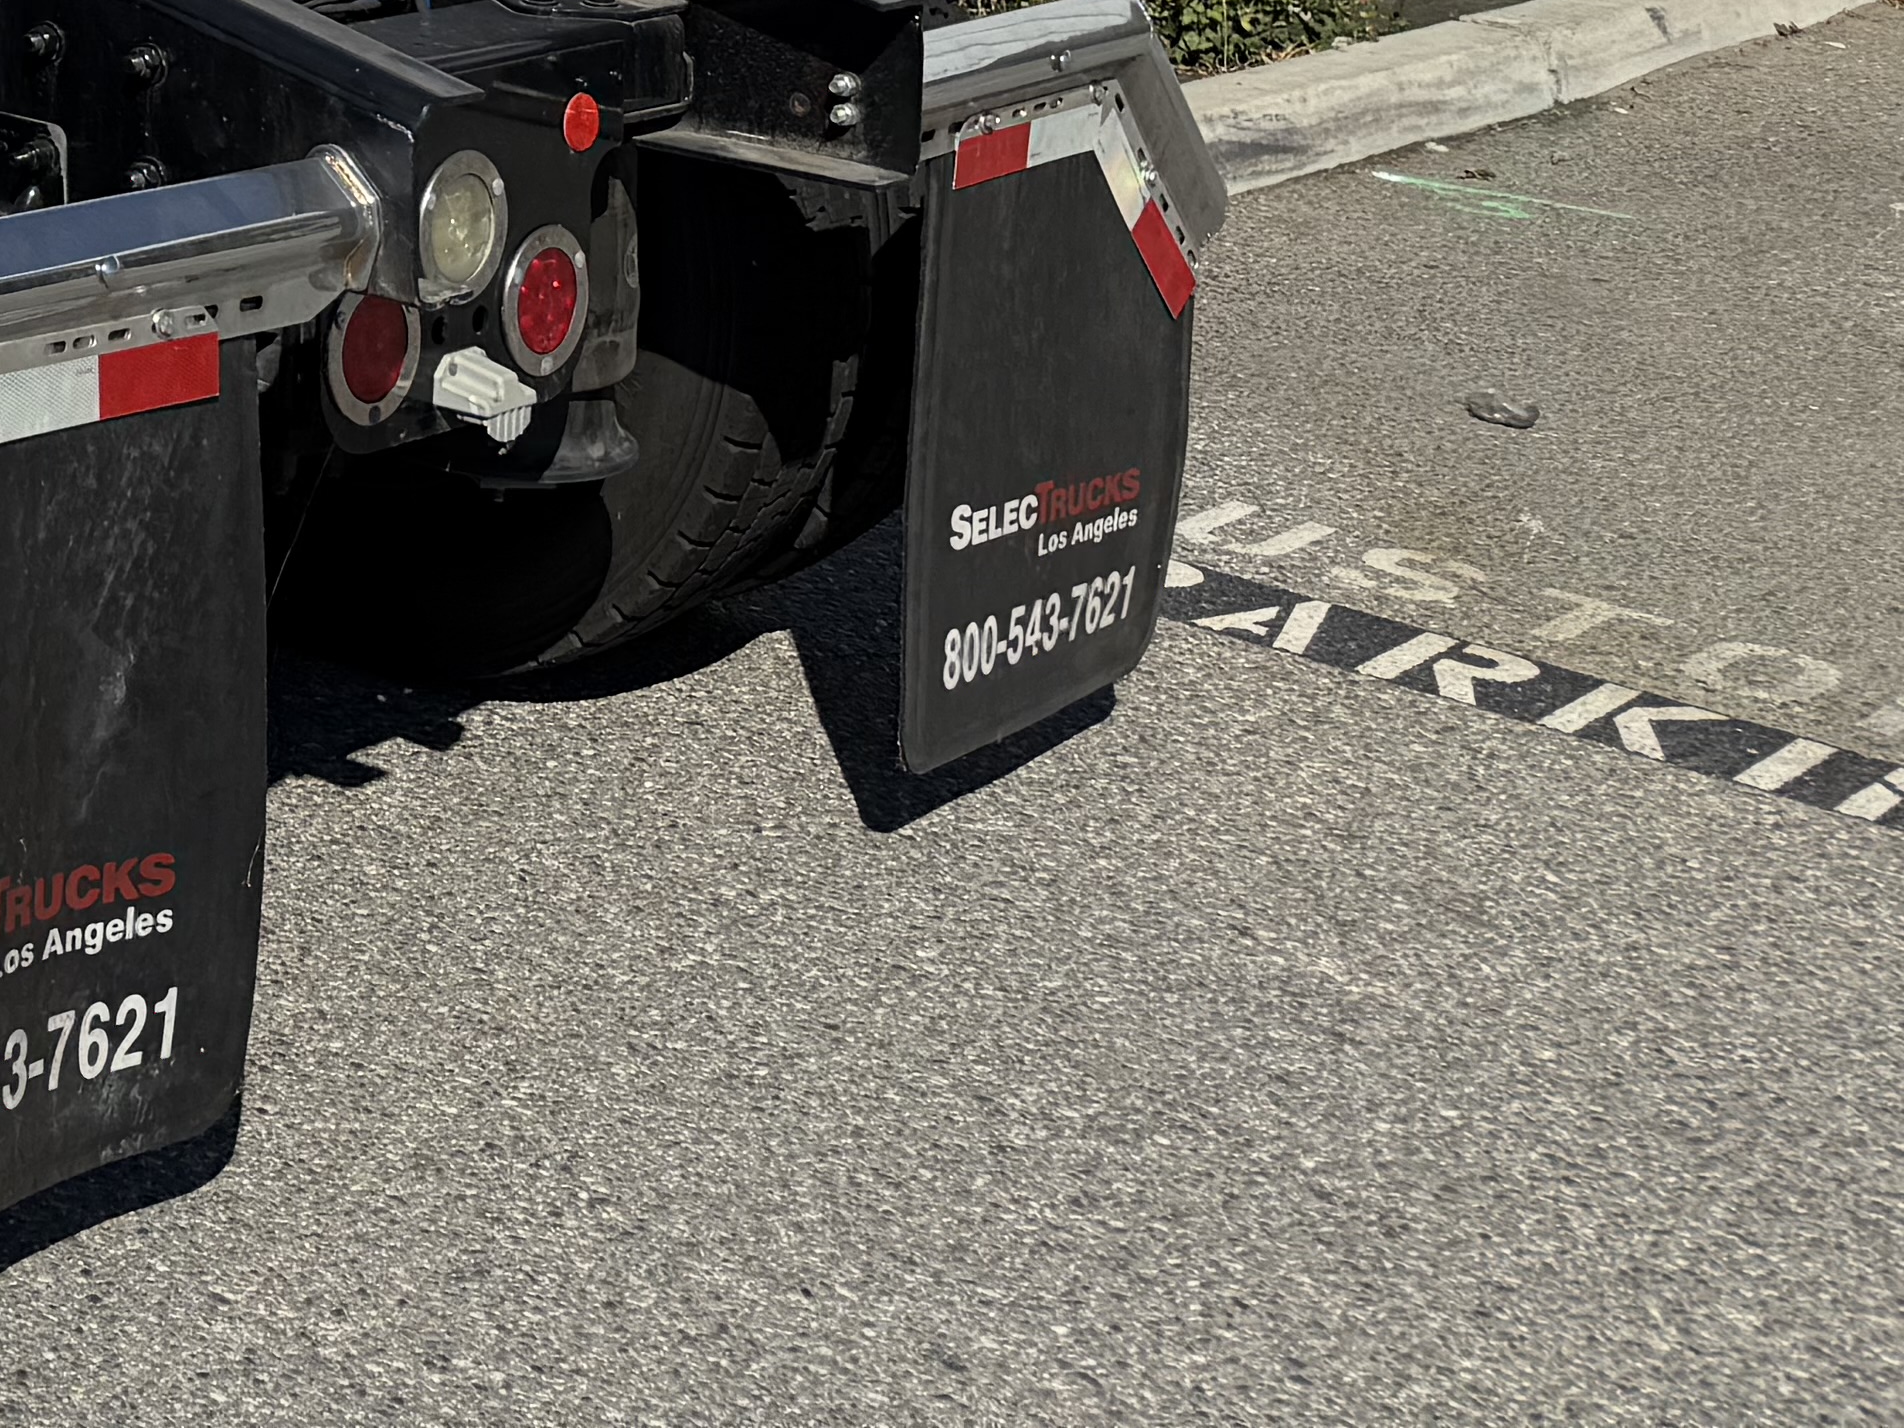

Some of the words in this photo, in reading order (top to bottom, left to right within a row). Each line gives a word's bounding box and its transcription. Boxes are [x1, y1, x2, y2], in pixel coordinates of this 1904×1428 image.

[949, 467, 1141, 551] SELECTRUCKS
[1037, 531, 1067, 557] Los
[1071, 507, 1138, 546] Angeles
[942, 565, 1137, 691] 800-543-7621
[1172, 500, 1904, 736] USTO
[41, 906, 175, 962] Angeles
